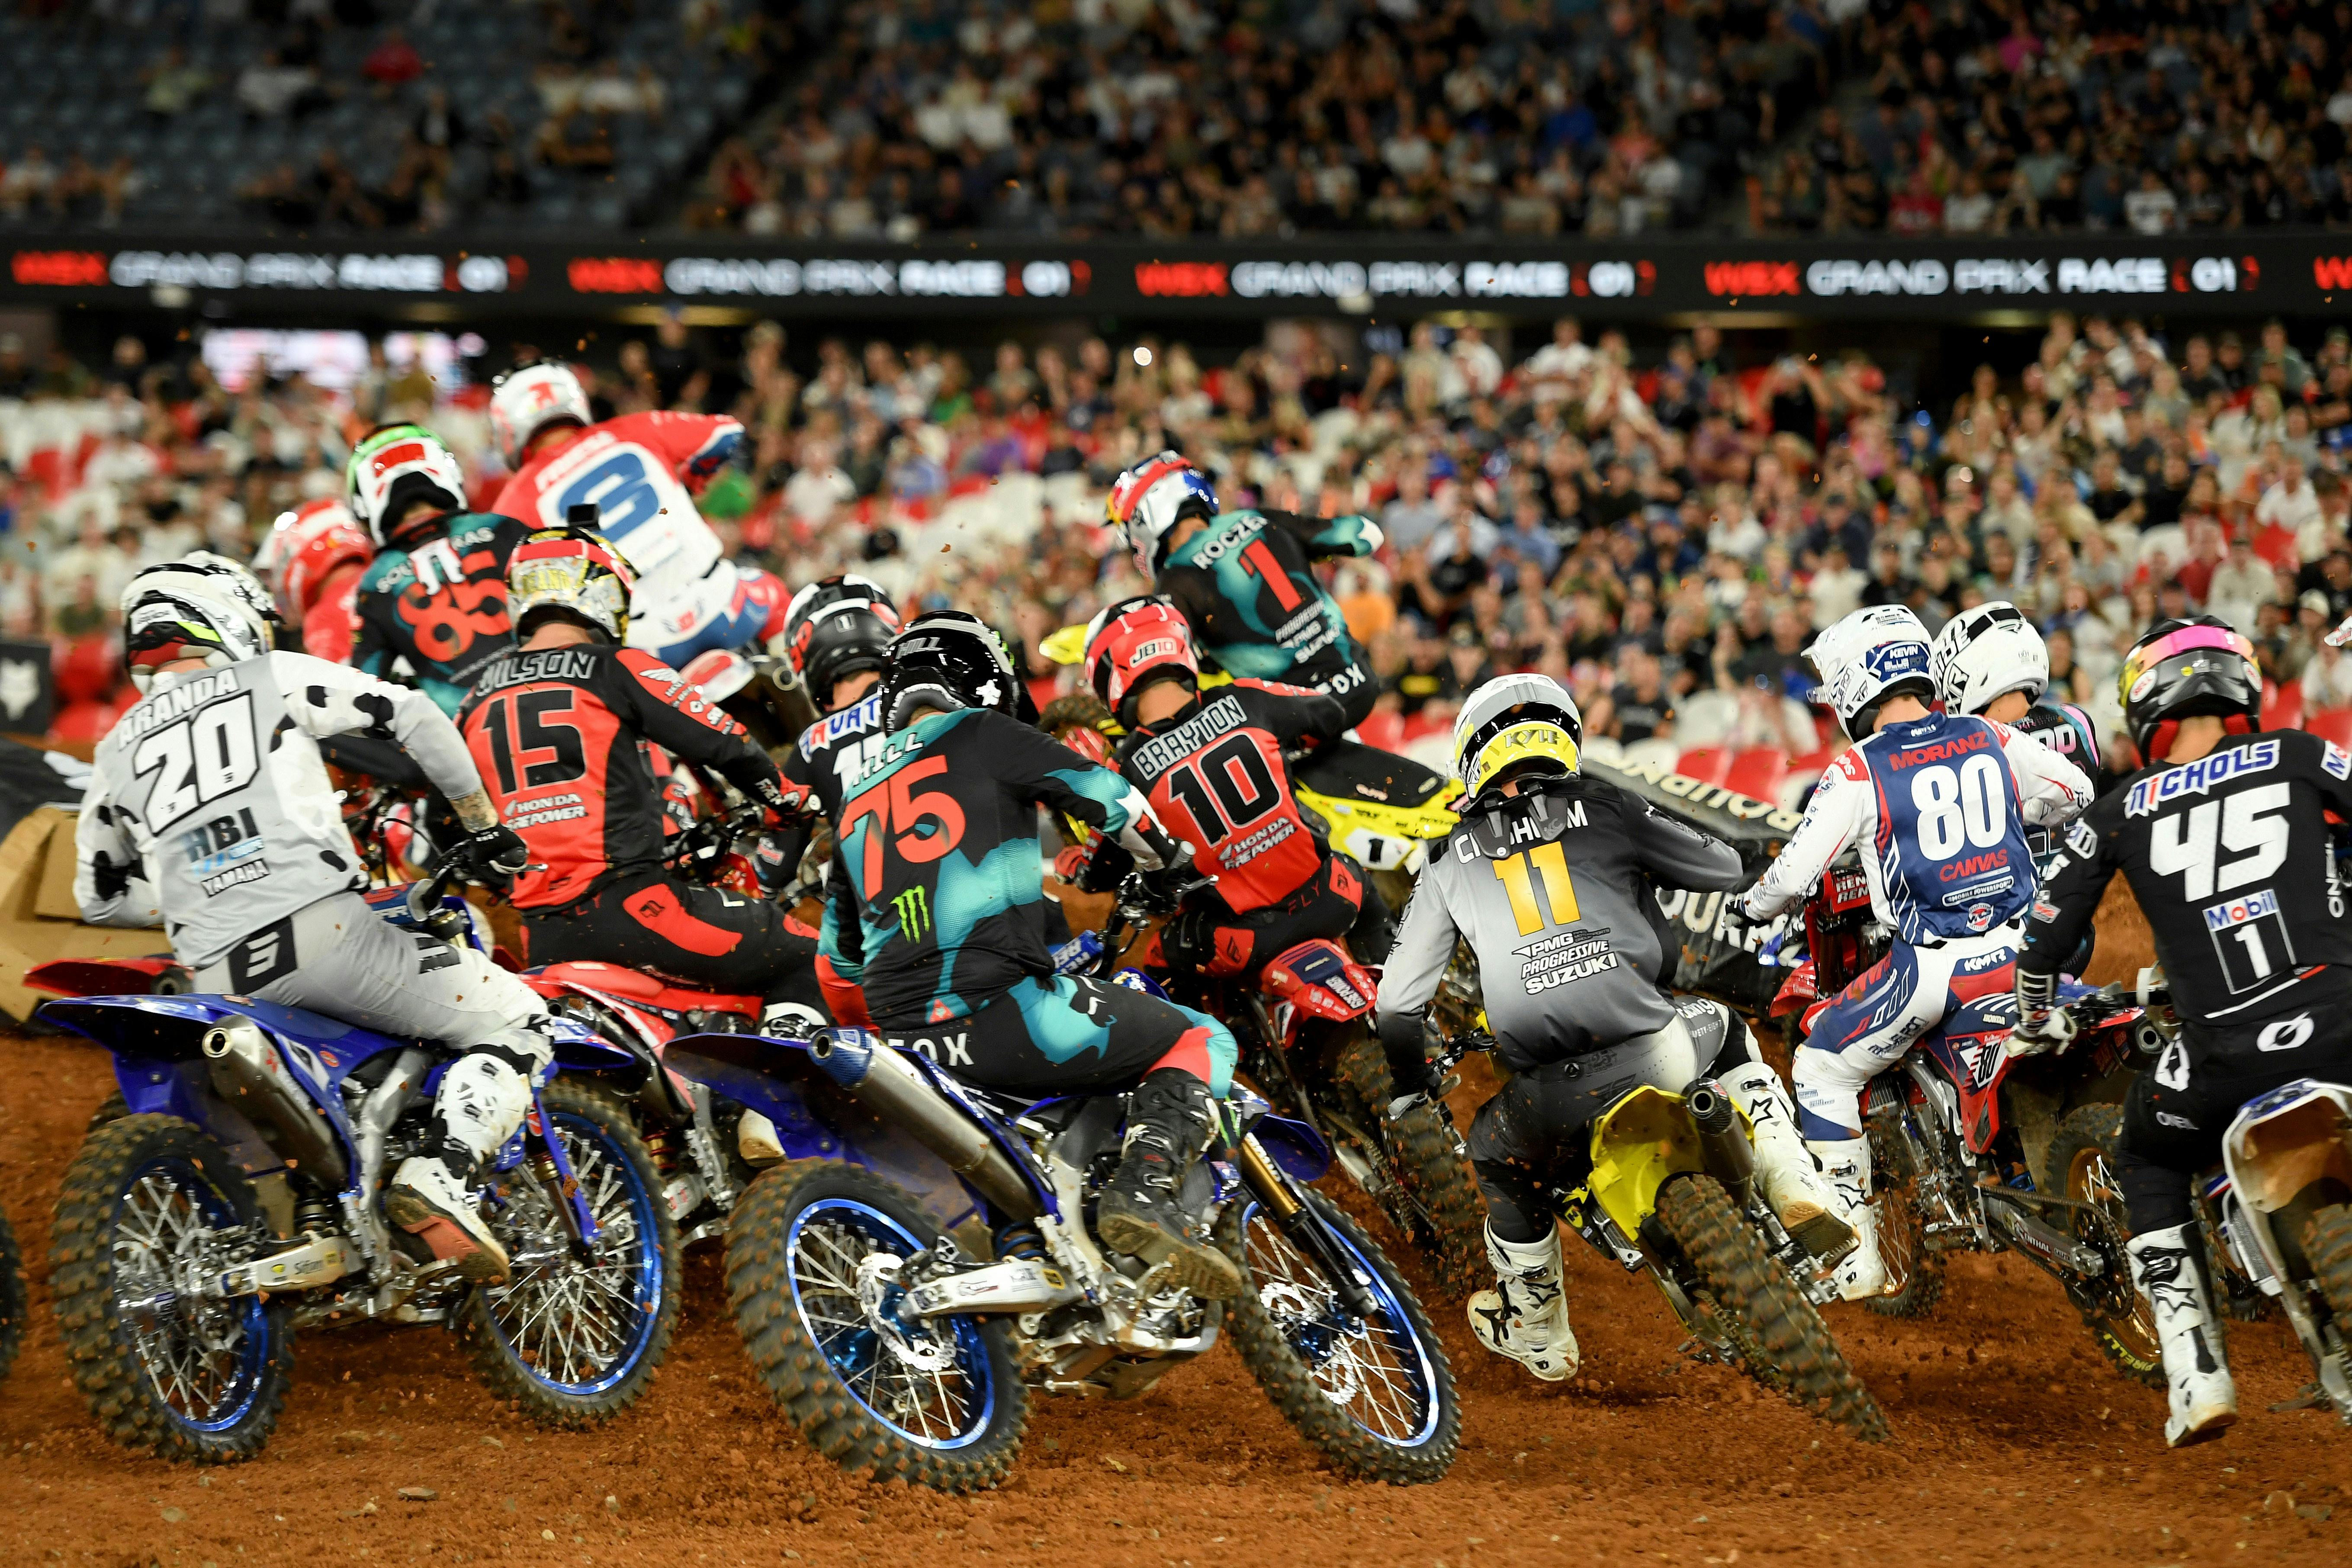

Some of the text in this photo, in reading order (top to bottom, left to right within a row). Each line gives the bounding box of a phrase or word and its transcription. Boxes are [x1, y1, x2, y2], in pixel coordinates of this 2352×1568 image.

[2057, 258, 2166, 293] RACE
[1888, 645, 1918, 659] KEVIN
[118, 668, 241, 752] ARANDA
[479, 689, 586, 795] 15
[1131, 694, 1248, 781] BRAYTON
[1504, 729, 1561, 749] KYLE
[1889, 731, 1990, 772] MORANZ
[132, 690, 260, 836] 20
[1168, 729, 1282, 848] 10
[1911, 753, 2007, 861] 80
[839, 754, 966, 902] 75
[1233, 816, 1289, 853] HONDA
[2149, 782, 2291, 903] 45
[1368, 838, 1385, 864] 1
[1938, 848, 2009, 883] CANVAS
[200, 858, 270, 898] YAMAHA
[1492, 840, 1581, 937] 11
[2207, 890, 2278, 930] Mobil
[1521, 940, 1610, 979] PROGRESSIVE
[1532, 931, 1575, 958] PMG
[2233, 923, 2272, 979] 1
[1525, 952, 1619, 995] SUZUKI
[1982, 1013, 2006, 1025] HONDA
